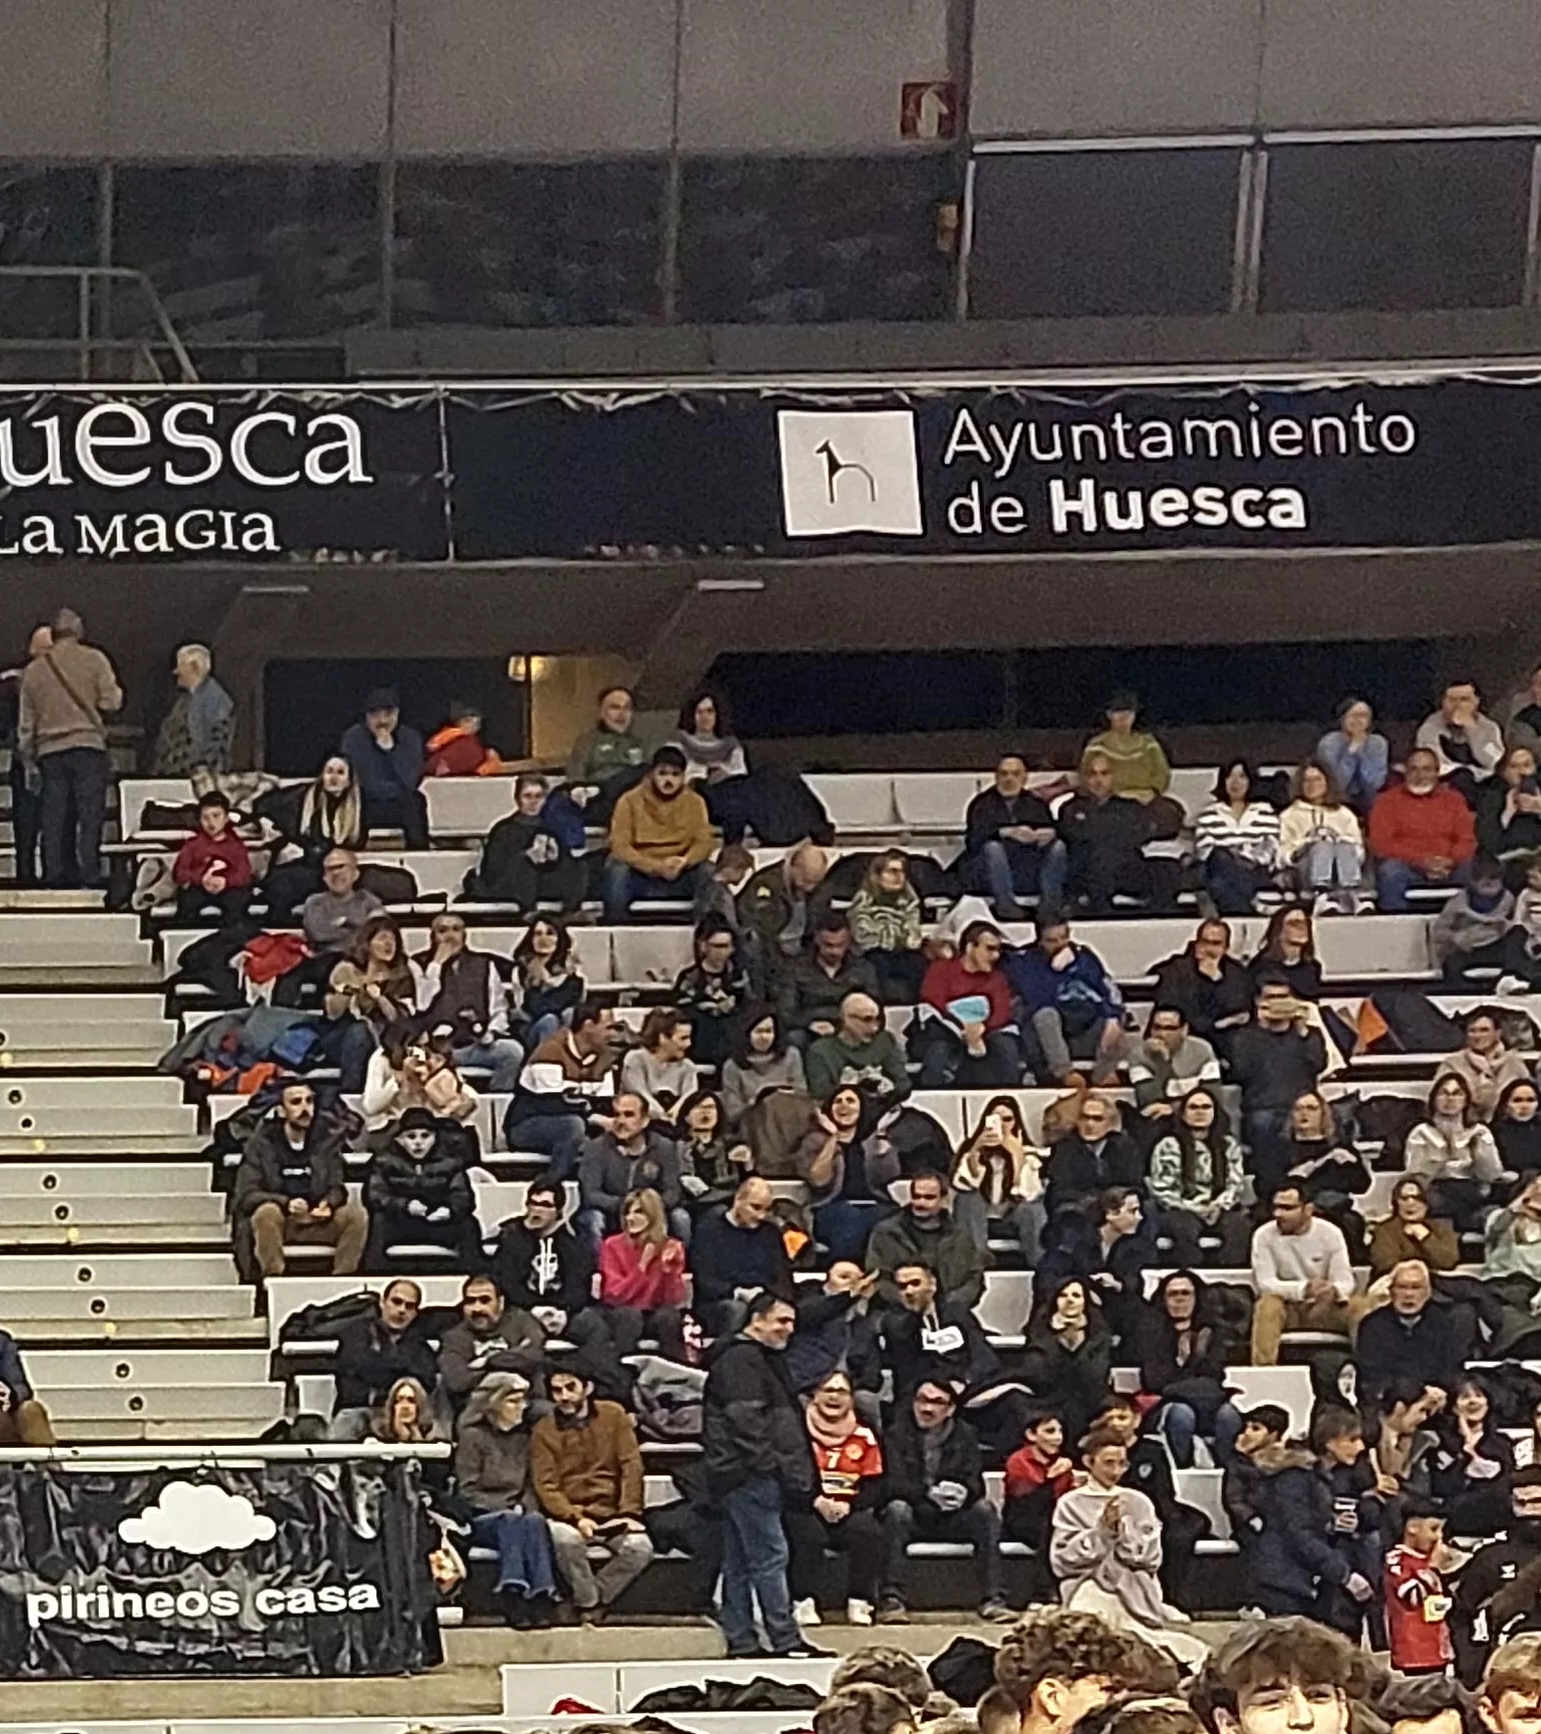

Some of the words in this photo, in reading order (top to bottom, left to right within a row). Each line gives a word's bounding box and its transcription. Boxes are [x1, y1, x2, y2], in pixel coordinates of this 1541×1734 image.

[944, 402, 1416, 478] Ayuntamiento
[947, 480, 1027, 534] de
[1048, 478, 1307, 533] Huesca
[26, 1585, 240, 1628] pirineos
[255, 1584, 381, 1616] casa
